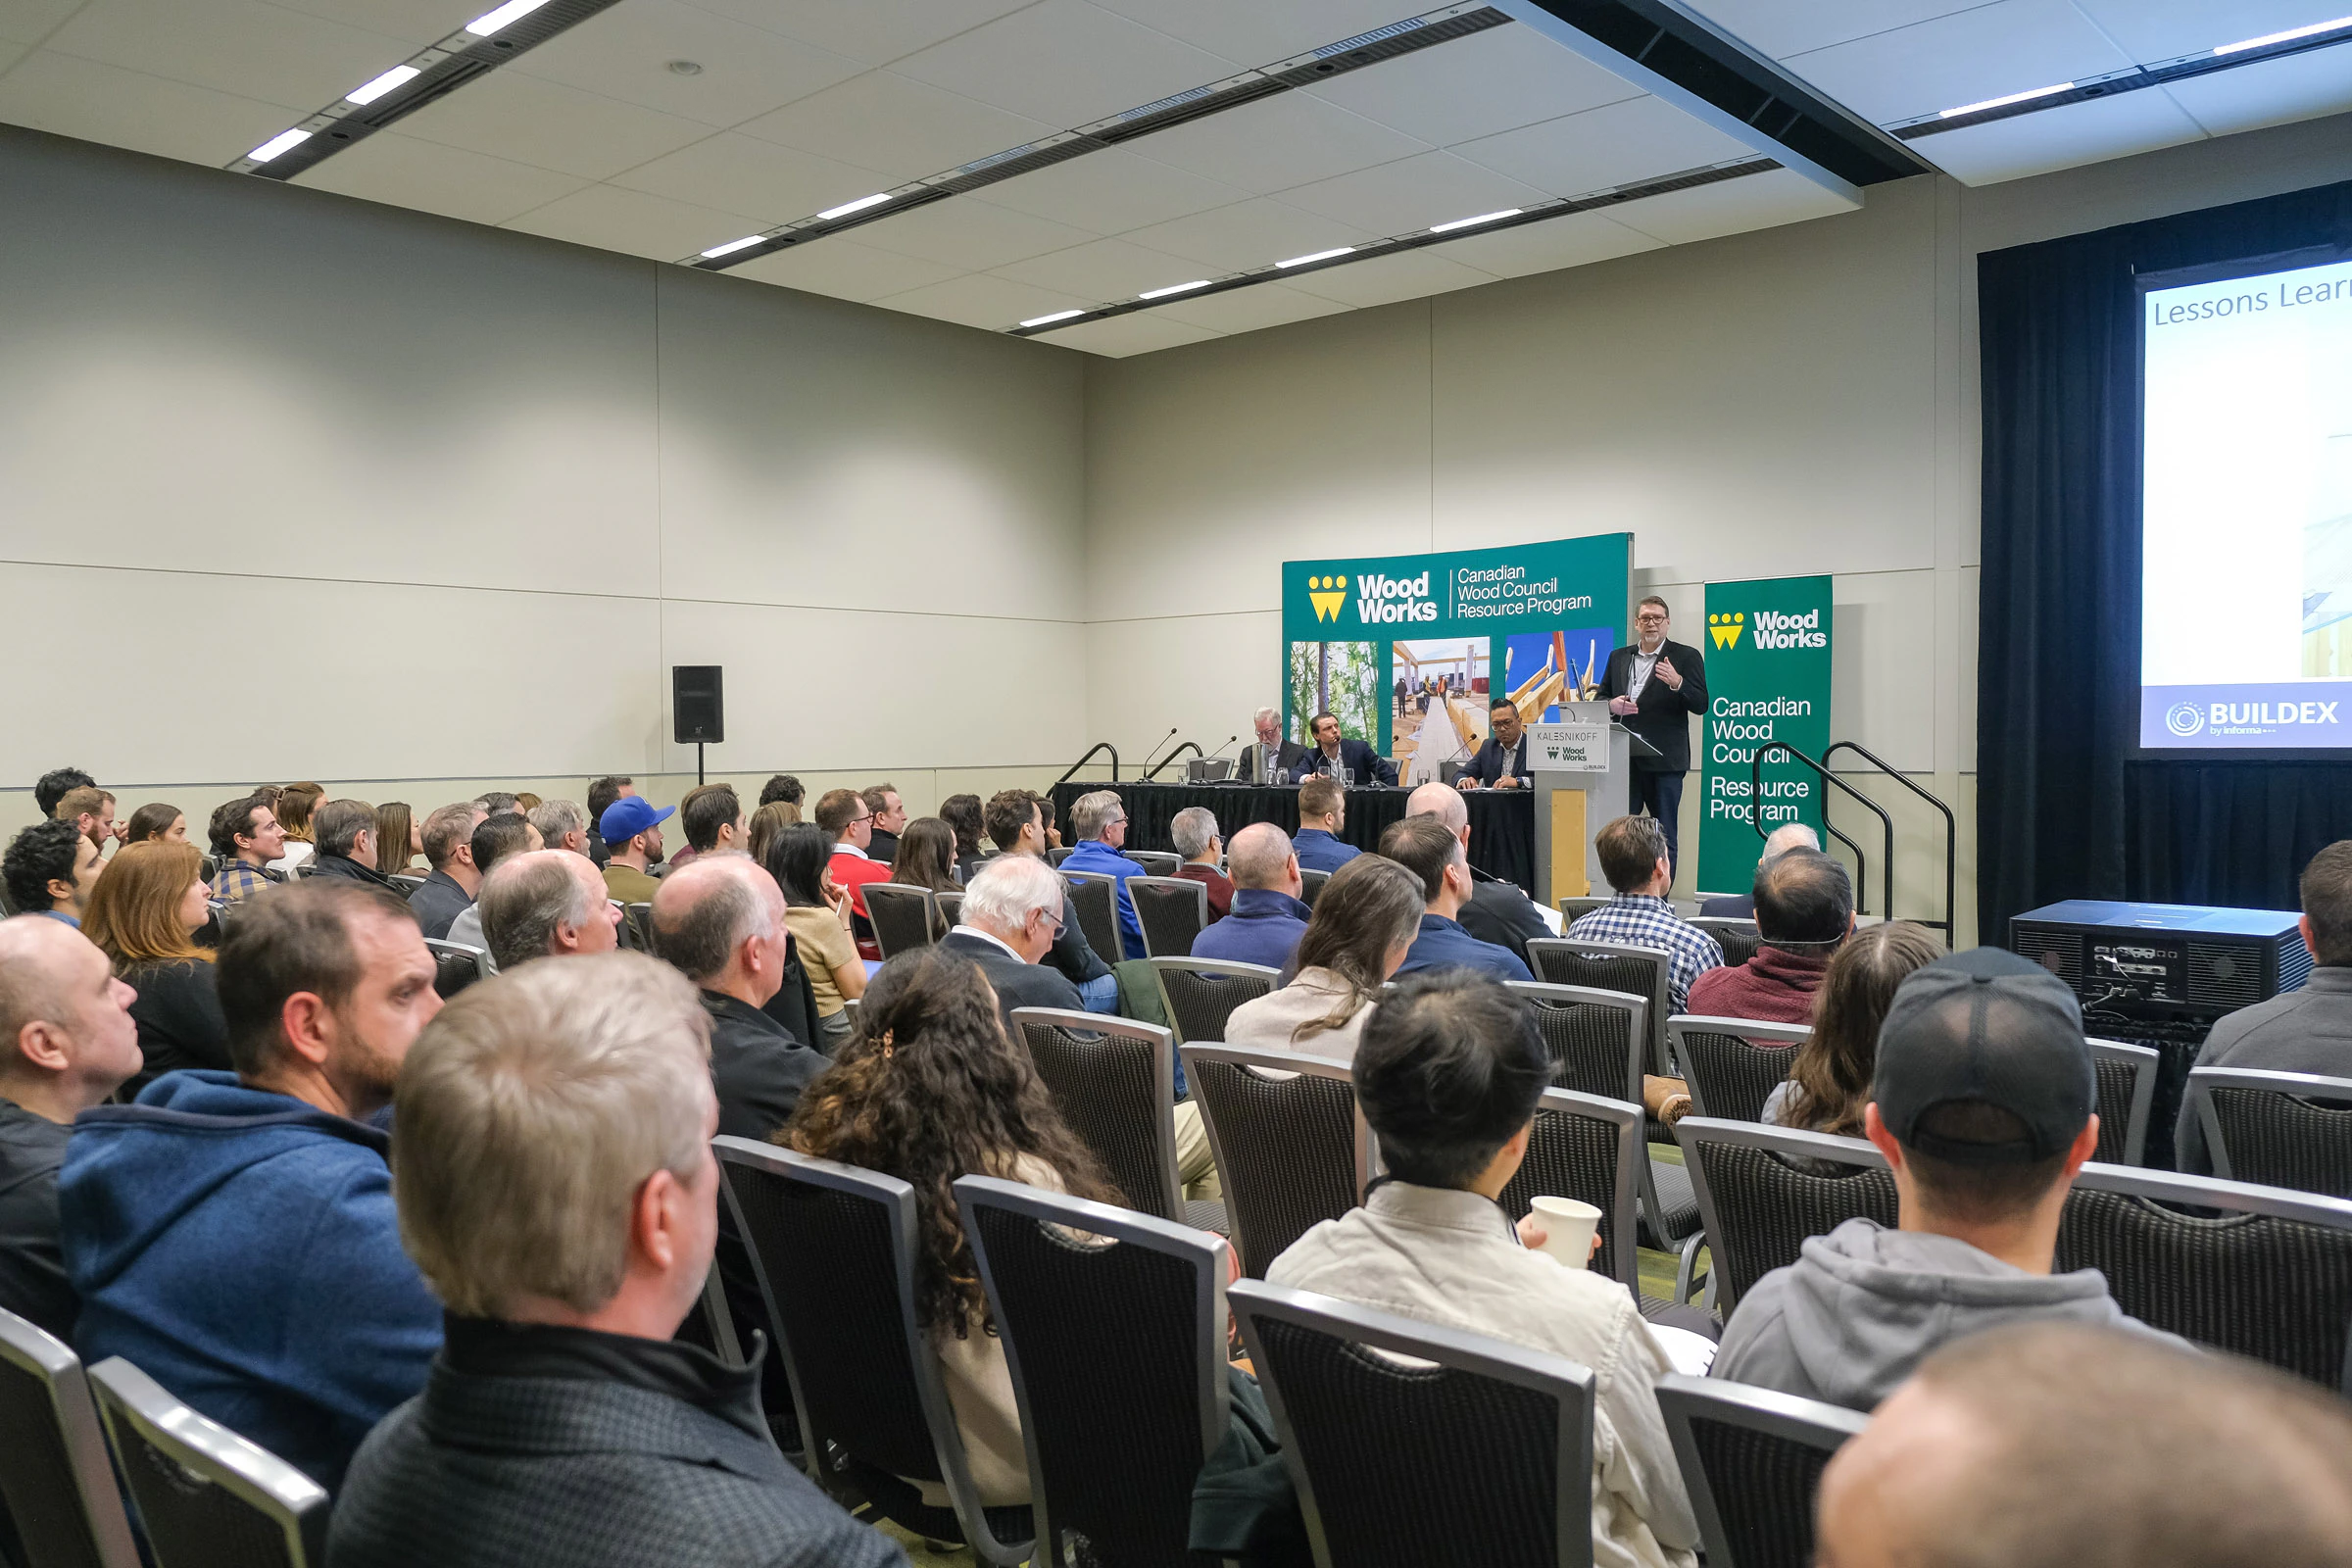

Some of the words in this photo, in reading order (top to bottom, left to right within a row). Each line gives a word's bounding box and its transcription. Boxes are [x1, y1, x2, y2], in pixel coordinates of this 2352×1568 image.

[2155, 292, 2269, 326] Lessons
[2280, 278, 2352, 308] Lear
[1457, 564, 1525, 584] Canadian
[1356, 571, 1429, 600] Wood
[1457, 583, 1499, 601] Wood
[1502, 577, 1557, 598] Council
[1356, 597, 1438, 623] Works
[1457, 602, 1524, 618] Resource
[1527, 595, 1592, 615] Program
[1753, 609, 1819, 631] Wood
[1752, 628, 1827, 650] Works
[1712, 696, 1811, 717] Canadian
[2210, 701, 2339, 725] BUILDEX
[1537, 731, 1597, 741] KALESNIKOFF
[1712, 719, 1773, 740] Wood
[2210, 726, 2223, 736] by
[2224, 725, 2262, 735] informa
[1562, 746, 1585, 755] Wood
